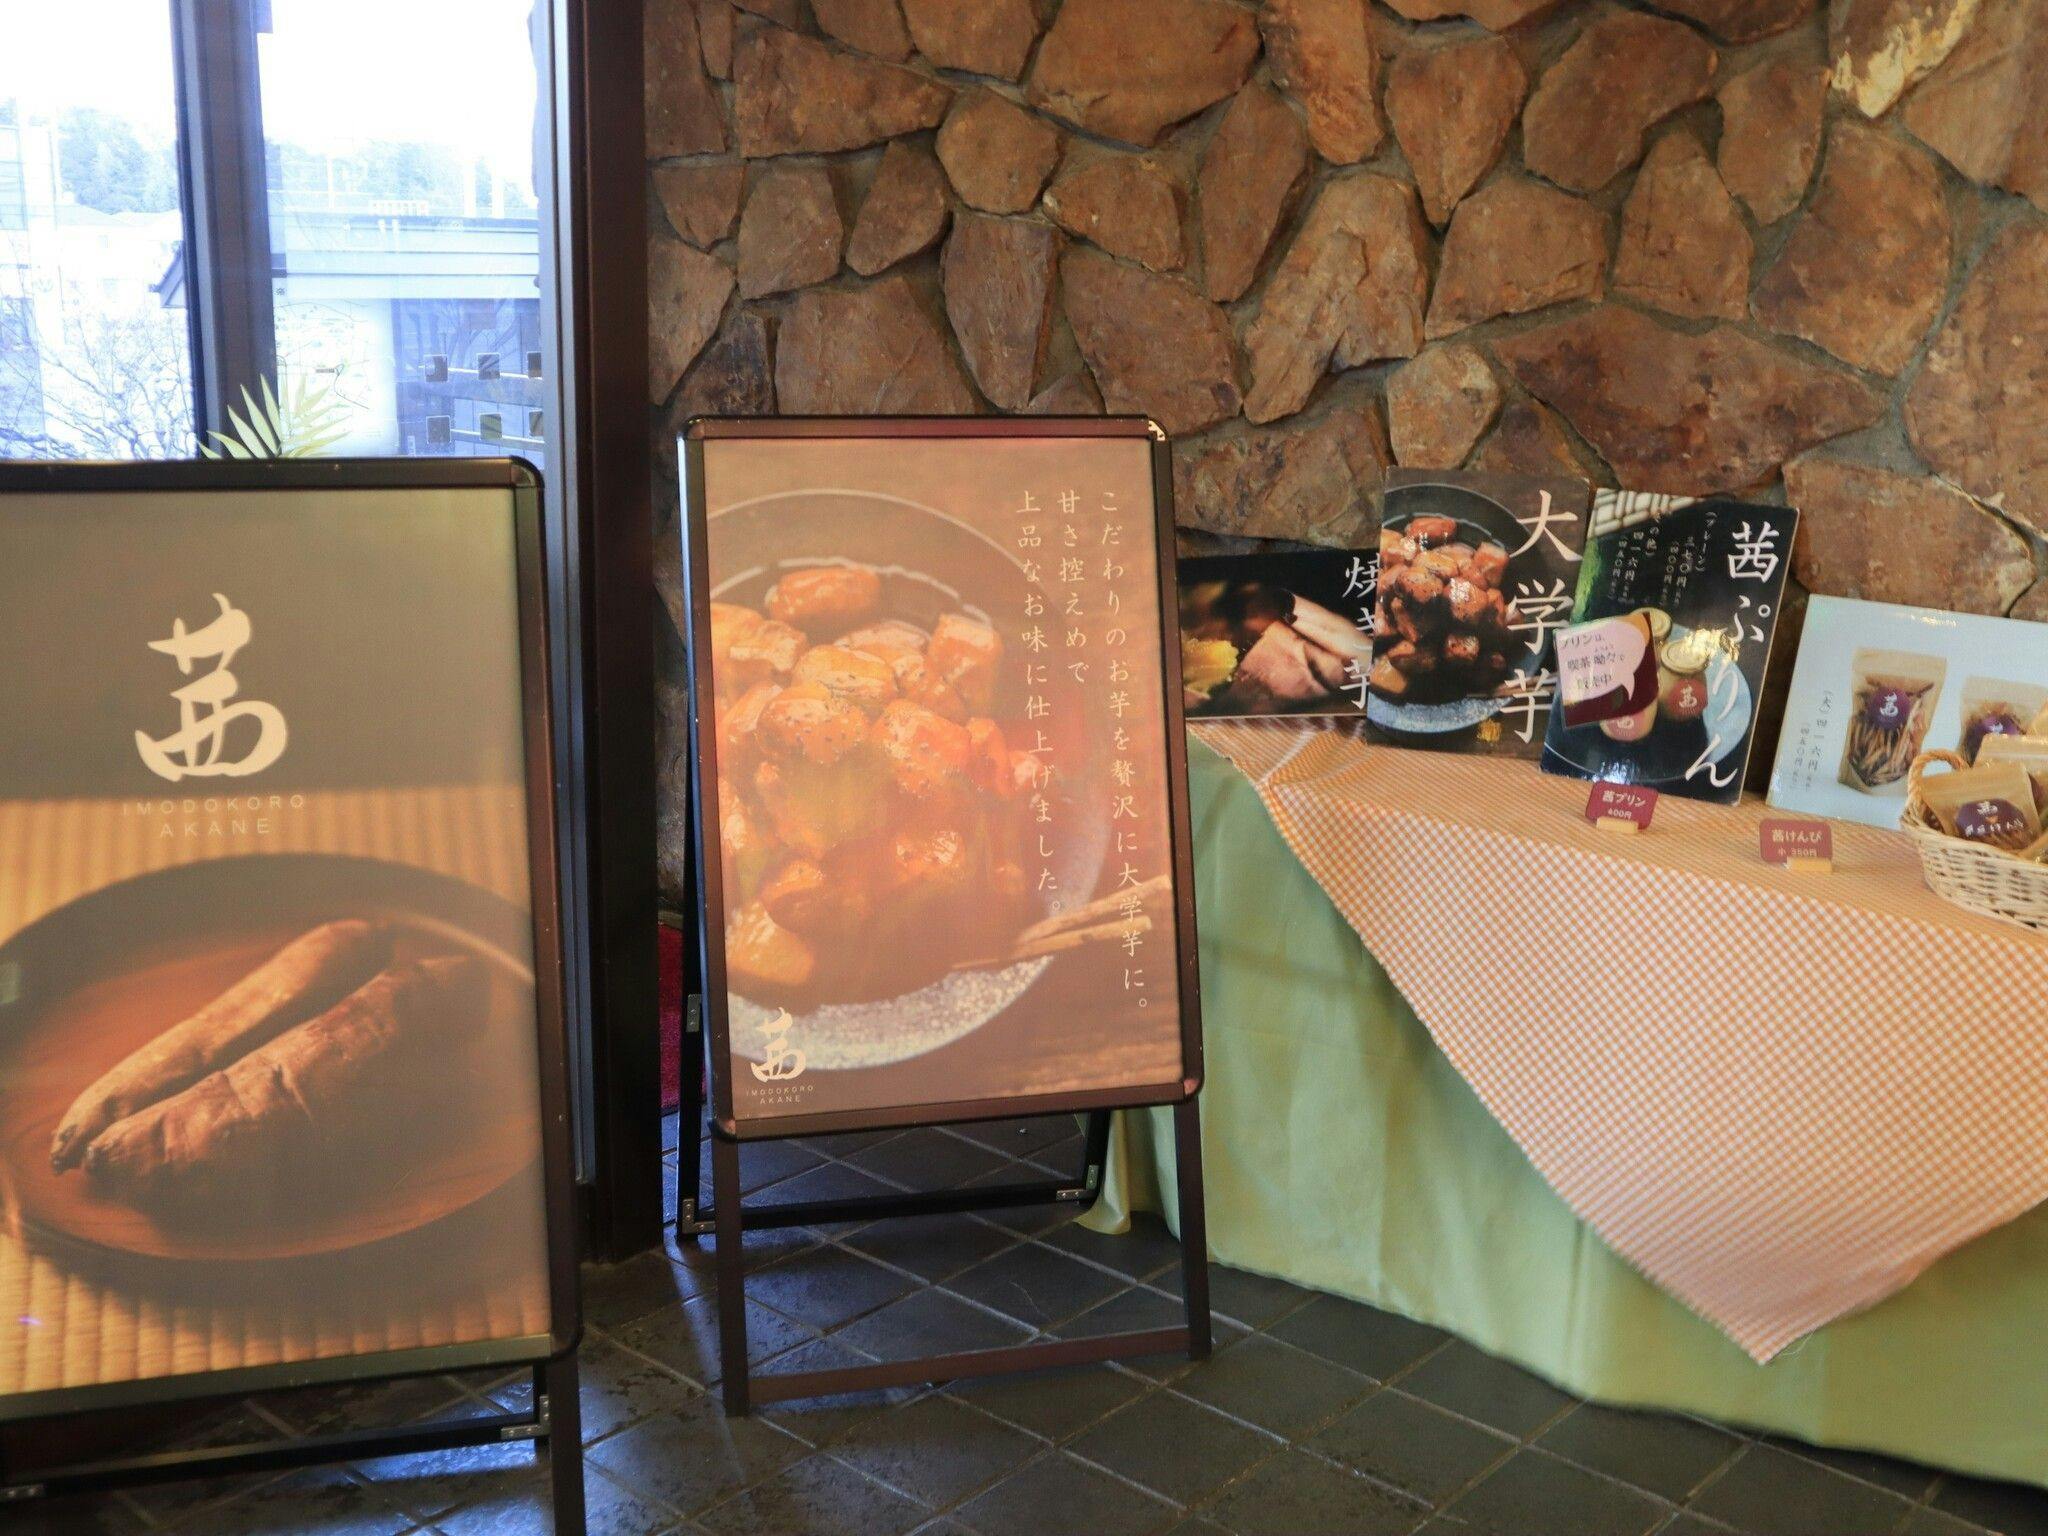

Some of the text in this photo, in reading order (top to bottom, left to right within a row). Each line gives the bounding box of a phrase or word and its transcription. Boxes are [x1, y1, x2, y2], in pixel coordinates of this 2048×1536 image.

[1016, 490, 1061, 911] 上品なお味に仕上げました。
[1057, 489, 1090, 683] 甘さ控えめで
[1499, 489, 1583, 744] 大学芋
[1685, 520, 1780, 788] 茜ぷりん
[123, 794, 305, 816] IMODOKORO
[159, 818, 271, 838] AKANE
[1101, 491, 1148, 1008] こだわりのお芋を贅沢に大学芋に。
